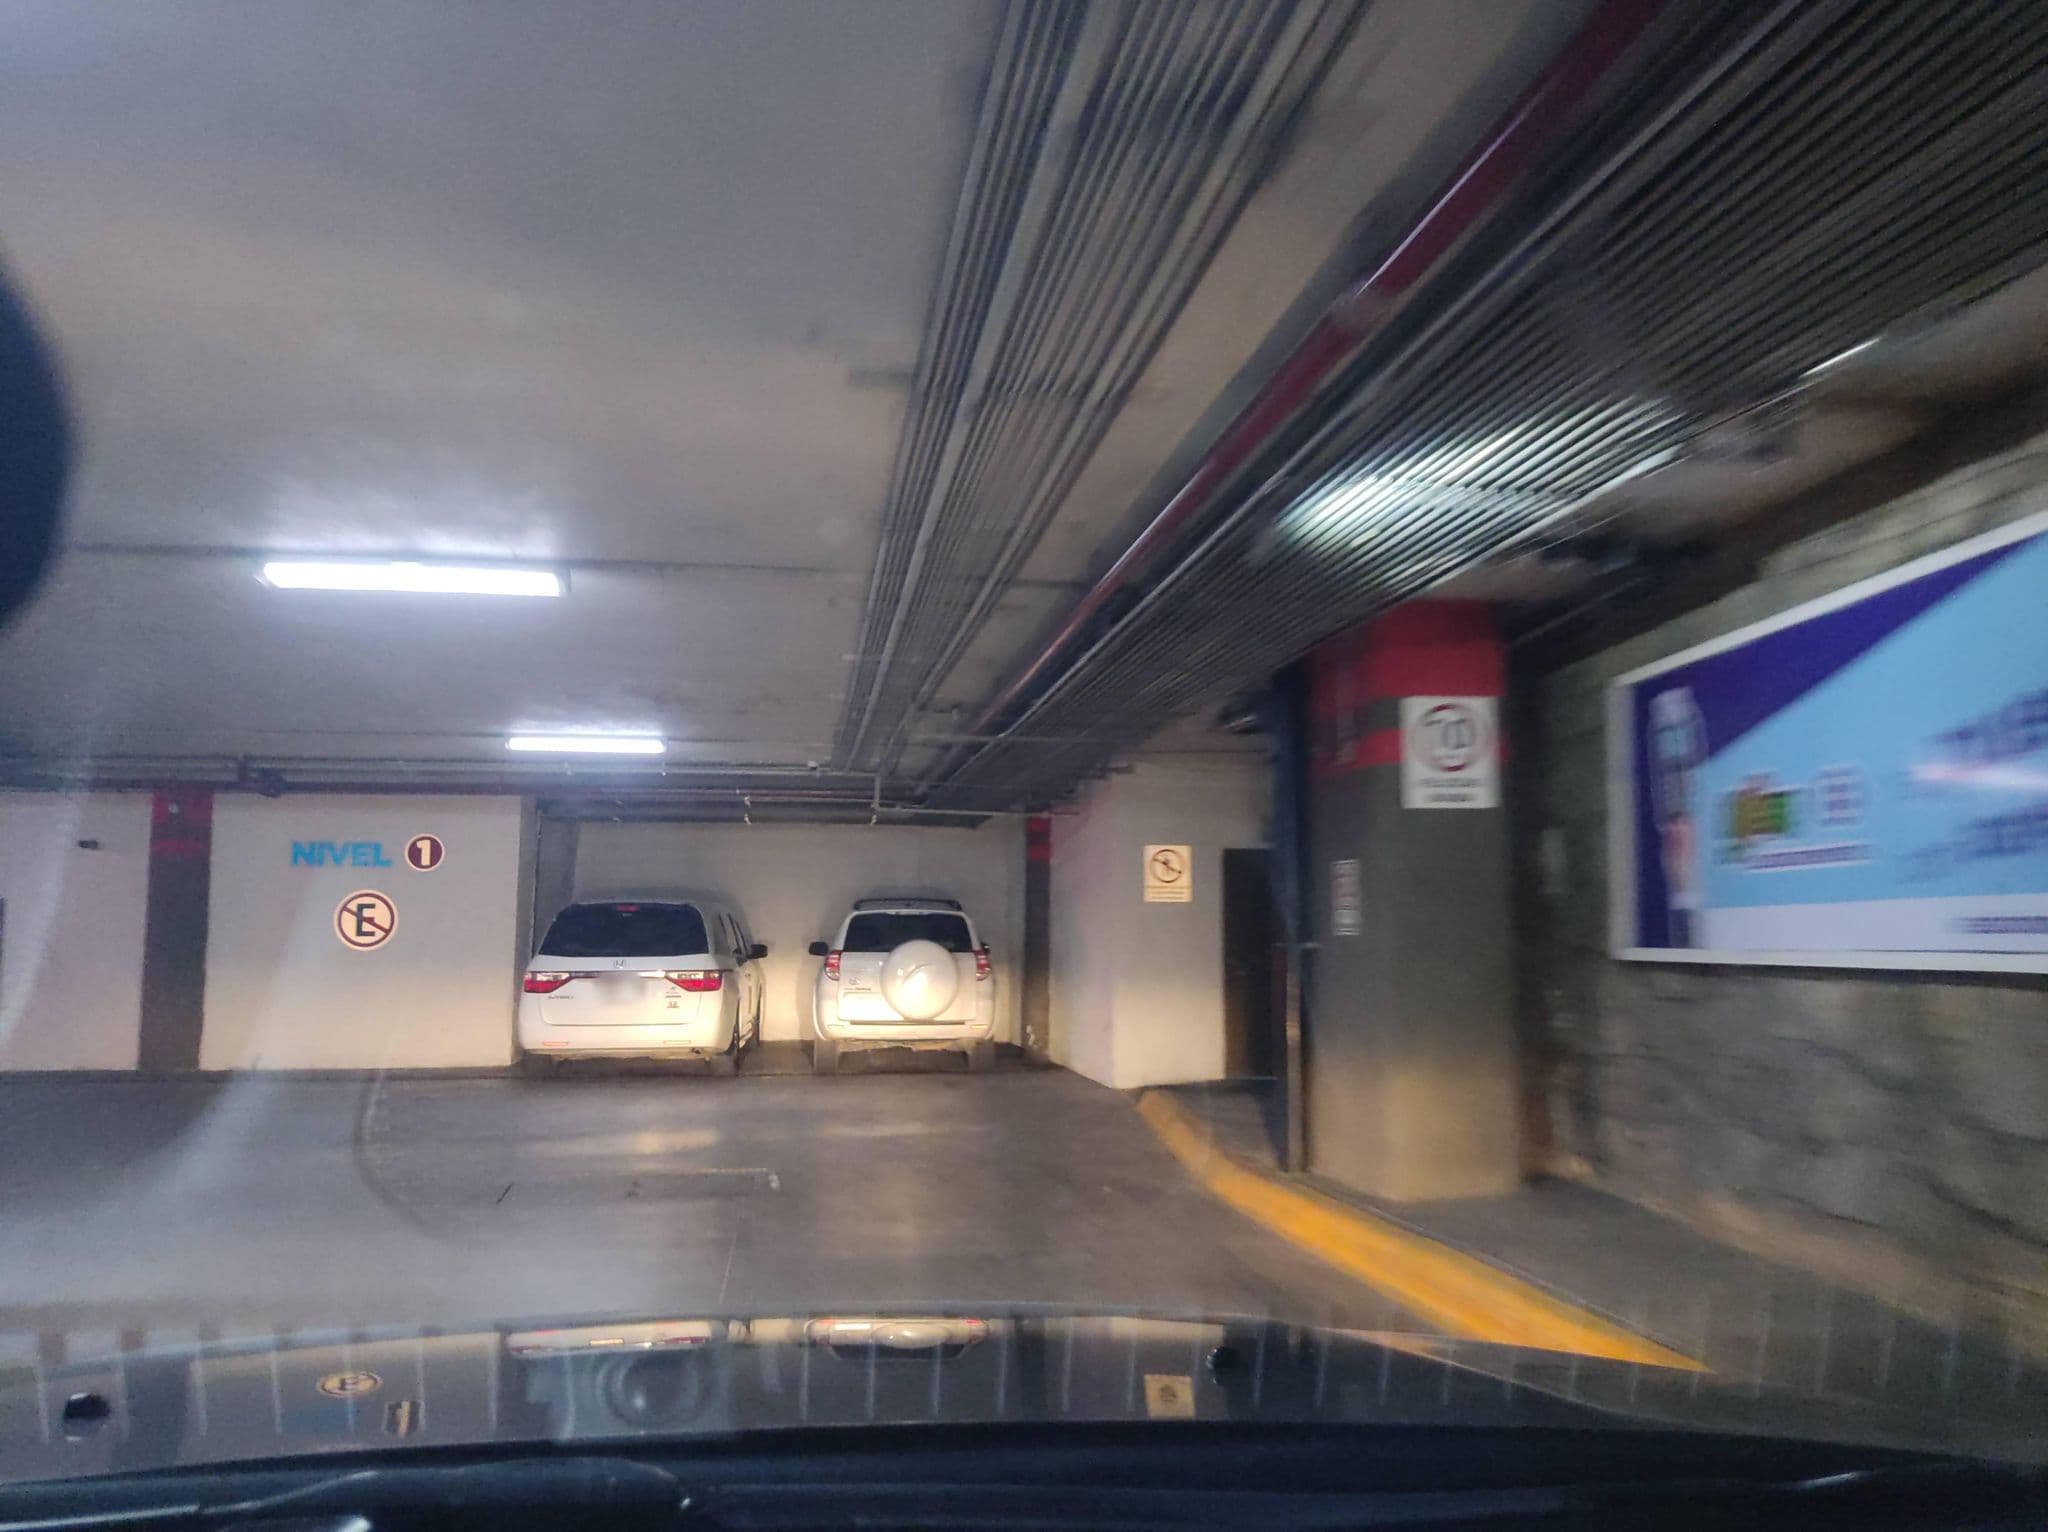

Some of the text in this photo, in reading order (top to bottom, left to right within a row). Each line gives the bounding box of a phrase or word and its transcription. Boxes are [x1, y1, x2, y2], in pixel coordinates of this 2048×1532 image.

[291, 839, 431, 867] NIVEL 1
[355, 903, 376, 937] E
